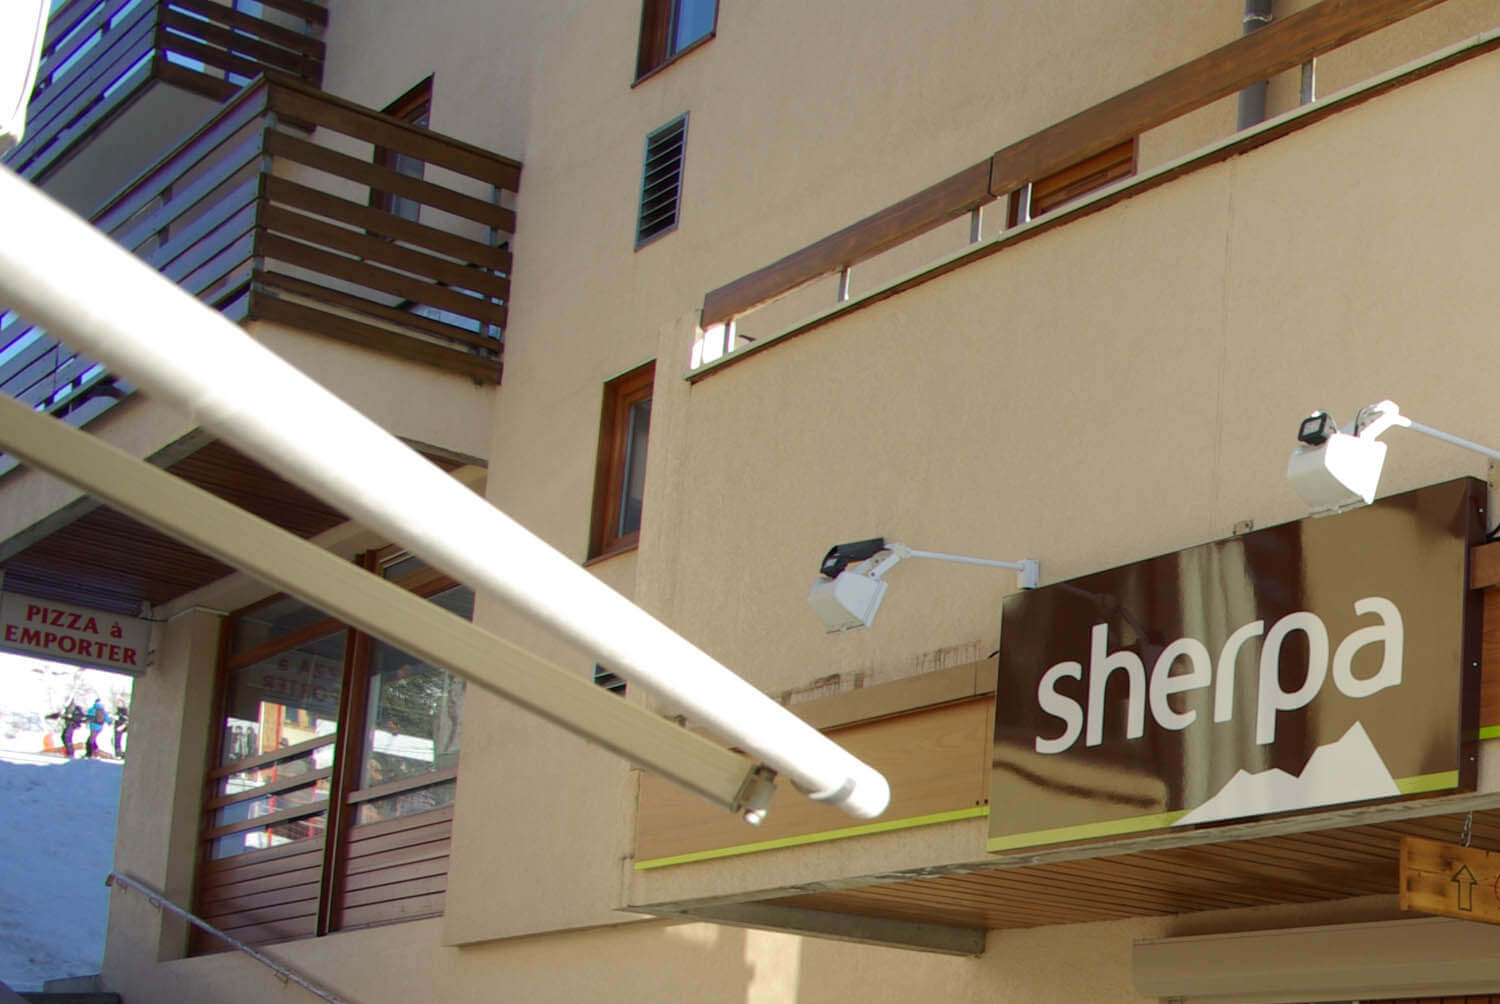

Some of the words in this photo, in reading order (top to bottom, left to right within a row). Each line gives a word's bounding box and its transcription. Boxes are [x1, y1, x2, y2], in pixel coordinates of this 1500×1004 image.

[26, 603, 99, 635] PIZZA
[4, 623, 138, 666] EMPORTER
[1035, 596, 1405, 755] sherpa
